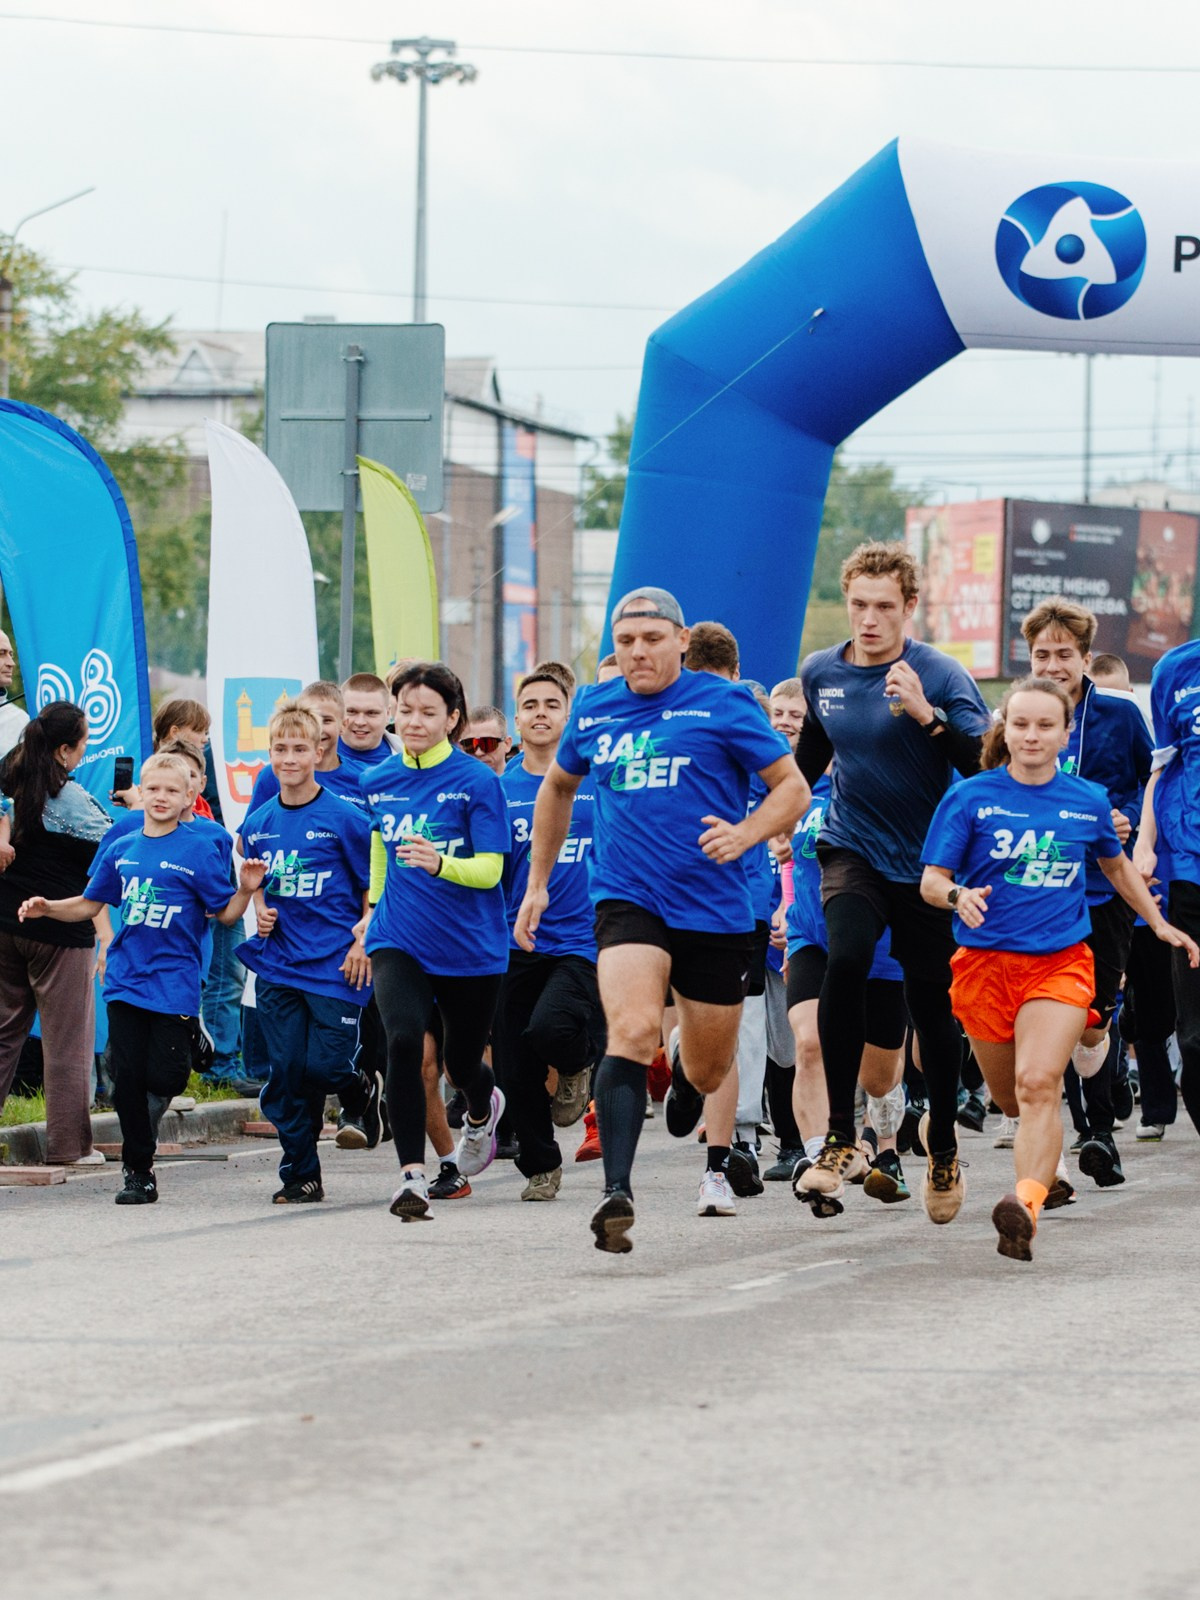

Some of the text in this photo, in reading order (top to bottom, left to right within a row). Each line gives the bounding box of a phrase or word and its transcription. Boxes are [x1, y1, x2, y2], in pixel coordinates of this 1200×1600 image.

[818, 688, 845, 698] LUKOIL
[673, 710, 711, 718] РОСАТОМ
[593, 730, 651, 765] ЗА!
[624, 756, 691, 790] БЕГ
[1069, 812, 1098, 822] РОСАТОМ
[557, 838, 592, 863] ЕГ
[989, 829, 1055, 860] ЗА!
[280, 870, 332, 897] БЕГ
[1021, 861, 1082, 887] БЕГ
[126, 902, 182, 929] БЕГ
